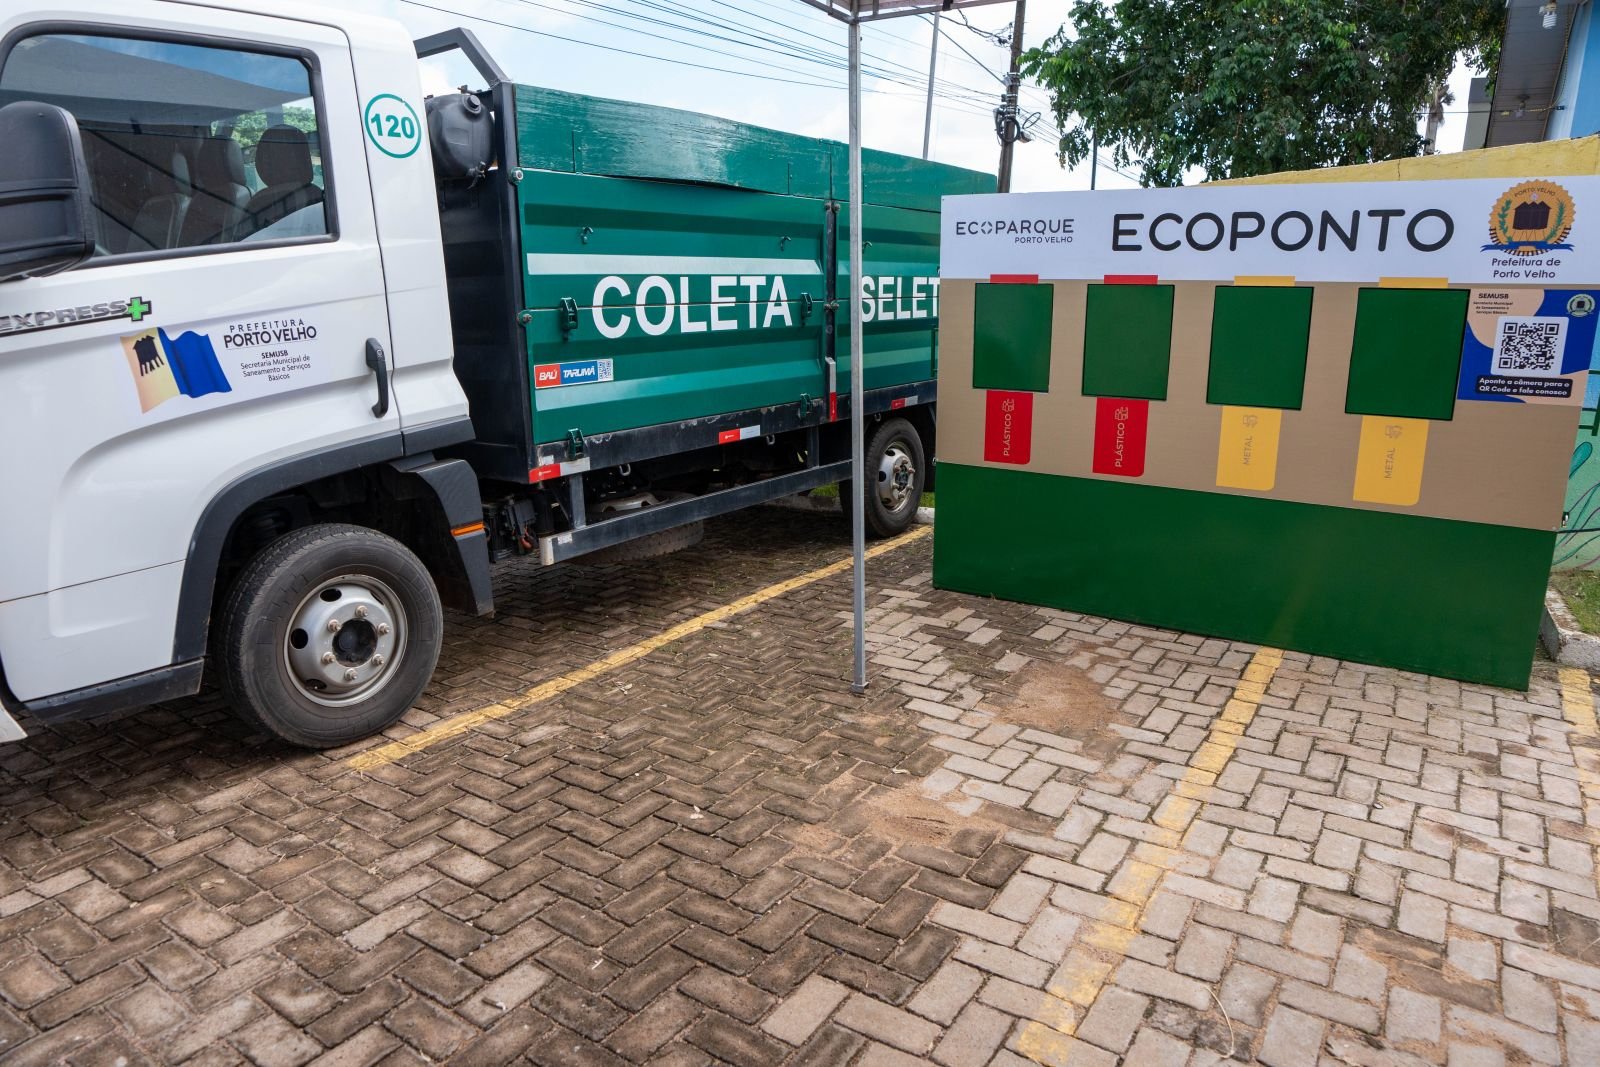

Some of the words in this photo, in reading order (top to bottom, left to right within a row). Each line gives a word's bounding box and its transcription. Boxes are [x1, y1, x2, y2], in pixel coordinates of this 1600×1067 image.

[370, 113, 415, 139] 120
[1514, 187, 1535, 197] PORTO
[1537, 187, 1556, 197] VELHO
[956, 219, 1075, 236] ECOPARQUE
[1112, 208, 1455, 252] ECOPONTO
[1014, 236, 1043, 244] PORTO
[1491, 258, 1543, 267] Prefeitura
[1546, 258, 1561, 267] de
[1493, 270, 1521, 279] Porto
[1524, 269, 1556, 279] Velho
[592, 275, 793, 339] COLETA
[861, 275, 940, 323] SELET
[230, 318, 304, 333] PREFEITURA
[223, 331, 271, 348] PORTO
[272, 325, 317, 342] VELHO
[240, 359, 272, 370] Secretaria
[272, 354, 302, 367] Municipal
[261, 350, 288, 359] SEMUSB
[243, 367, 280, 377] Saneamento
[286, 362, 312, 372] Serviços
[268, 373, 290, 381] Básicos
[539, 369, 558, 380] BAÚ
[562, 365, 596, 379] TARUMÁ
[1479, 377, 1506, 386] Aponte
[1514, 379, 1543, 387] câmera
[1003, 413, 1012, 457] PLÁSTICO
[1115, 422, 1126, 468] PLÁSTICO
[1243, 436, 1253, 466] METAL
[1384, 447, 1396, 480] METAL
